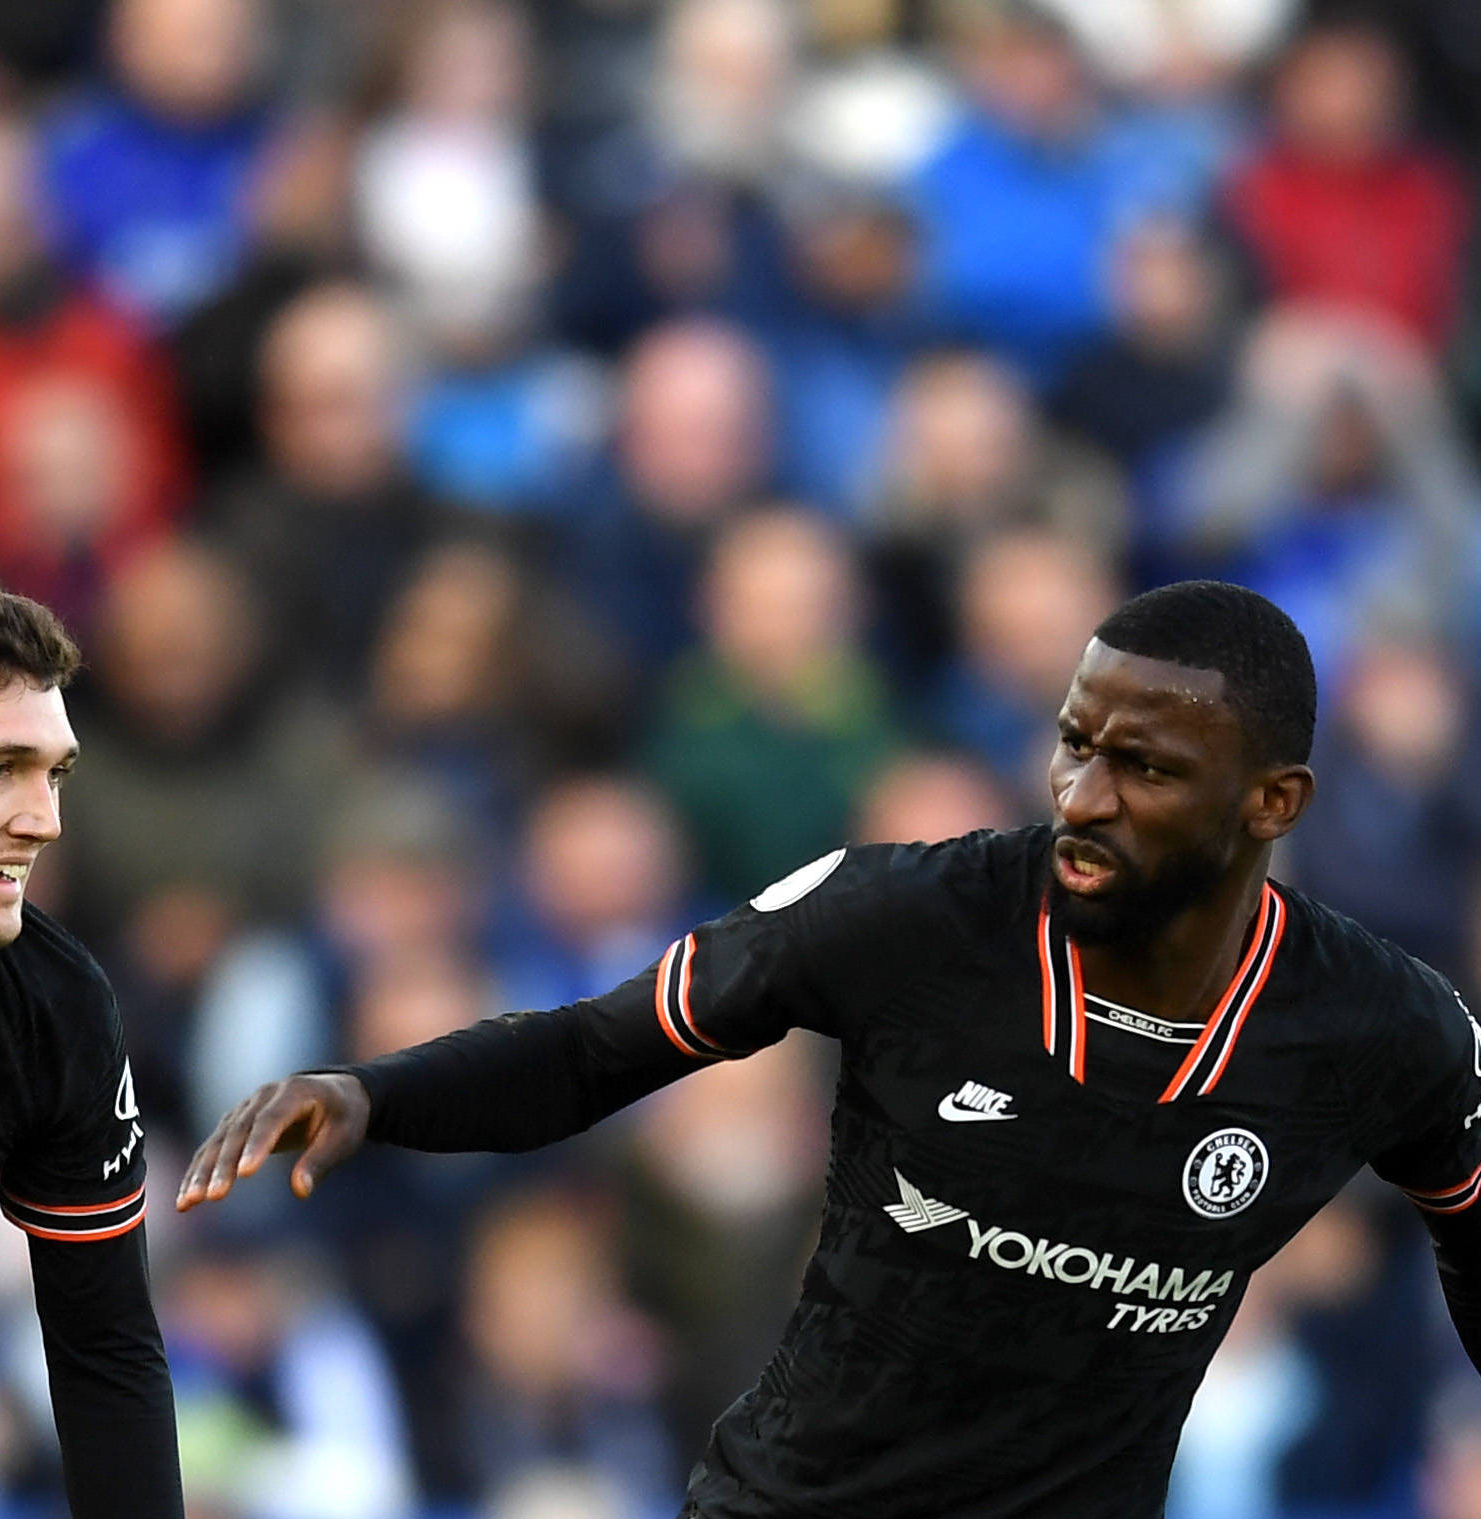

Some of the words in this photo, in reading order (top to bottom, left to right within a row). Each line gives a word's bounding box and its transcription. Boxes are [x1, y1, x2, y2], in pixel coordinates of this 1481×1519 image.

[1108, 1009, 1155, 1032] CHELSEA
[1157, 1026, 1174, 1038] FC
[954, 1079, 1013, 1116] NIKE
[1206, 1135, 1257, 1156] CHELSEA
[966, 1218, 1235, 1302] YOKOHAMA
[1106, 1303, 1217, 1334] TYRES
